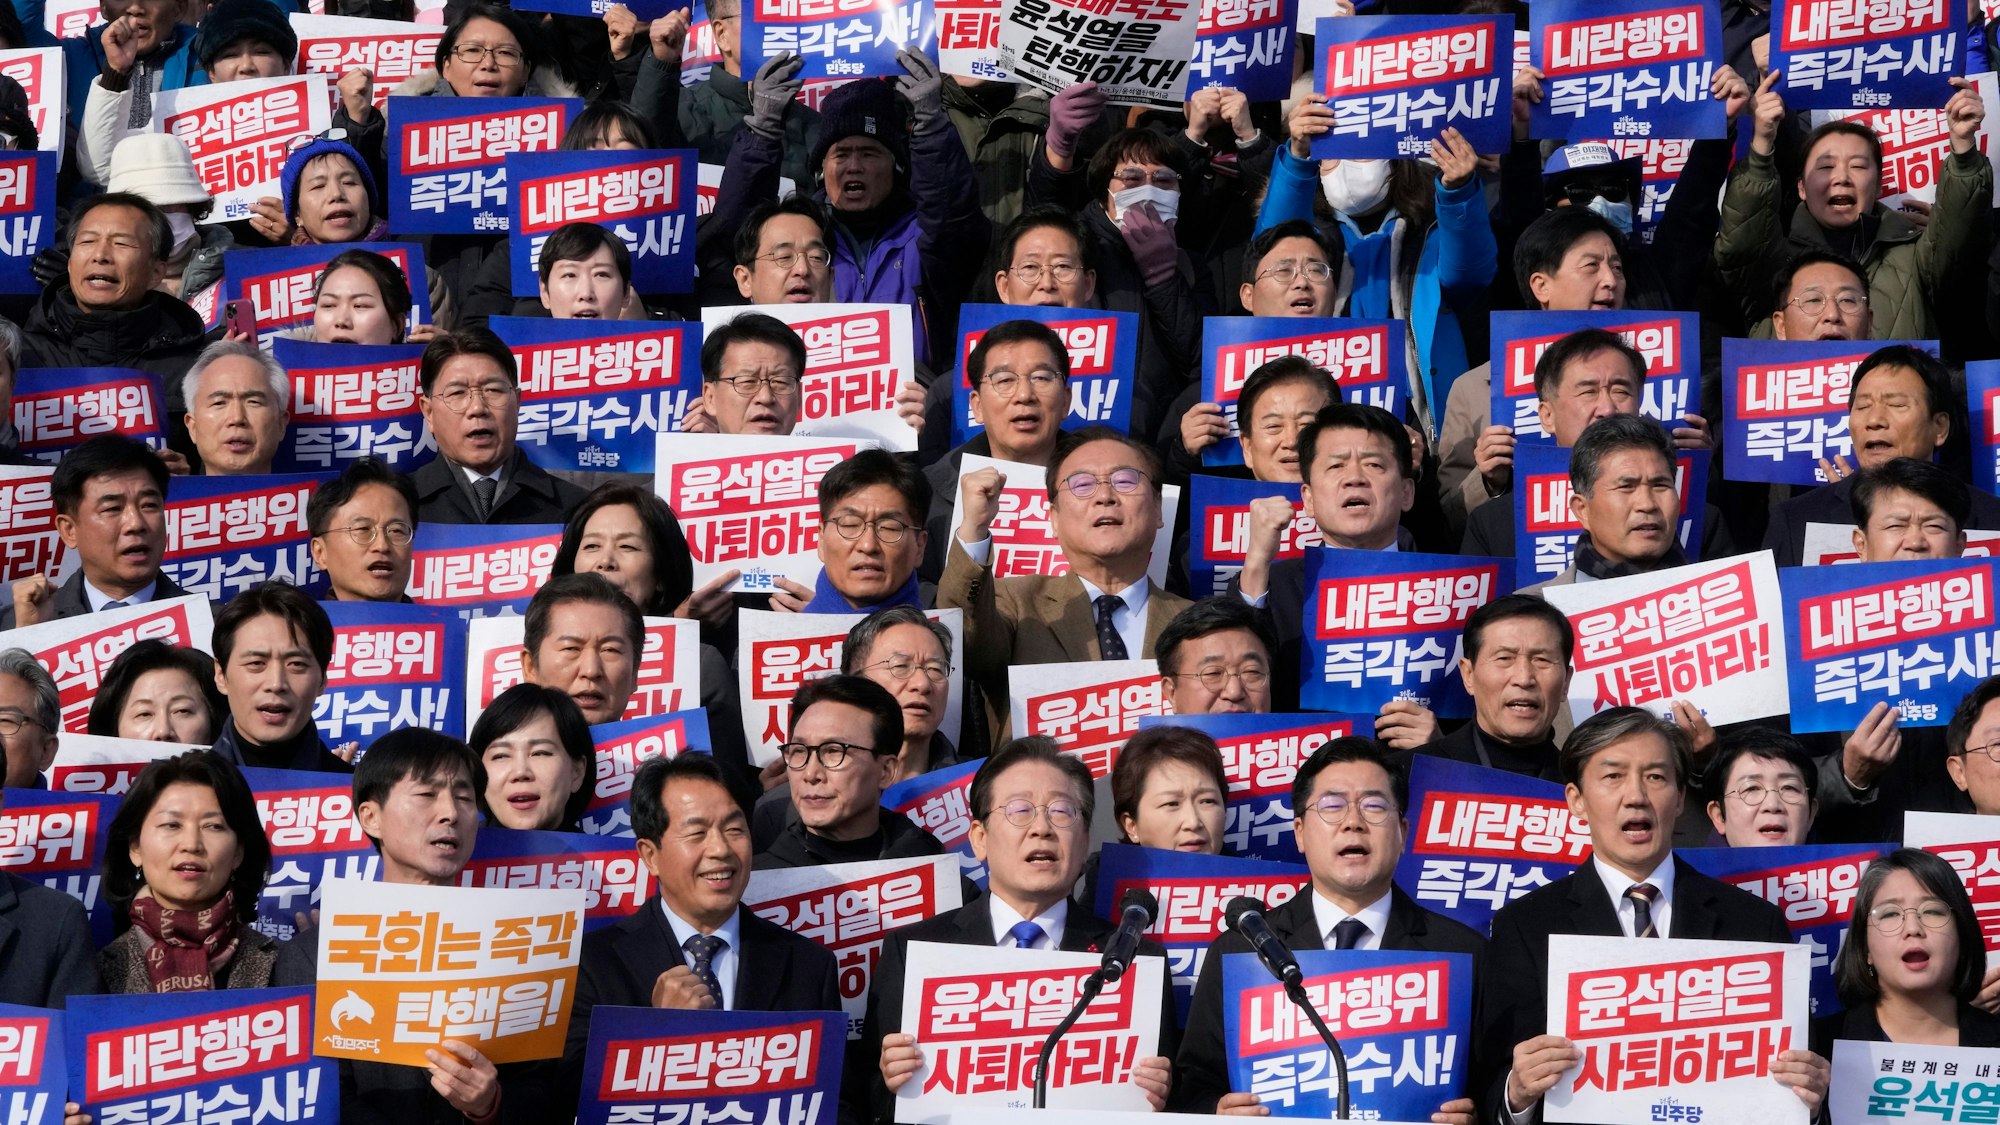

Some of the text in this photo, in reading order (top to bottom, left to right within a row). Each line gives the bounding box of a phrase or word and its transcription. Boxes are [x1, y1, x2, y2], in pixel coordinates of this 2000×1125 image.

[762, 3, 922, 57] 즉각수사!
[1009, 0, 1162, 54] 윤석열을
[1189, 26, 1288, 78] 각수사!
[1551, 13, 1698, 69] 내란행위
[306, 41, 440, 76] 윤석열은
[826, 62, 865, 75] 민주당
[1022, 36, 1187, 90] 탄핵하자!
[1334, 29, 1487, 88] 내란행위
[1787, 33, 1956, 90] 즉각수사!
[1334, 78, 1500, 138] 즉각수사!
[1550, 61, 1712, 118] 즉각수사!
[1852, 93, 1892, 107] 민주당
[172, 93, 301, 155] 윤석열은
[409, 111, 558, 167] 내란행위
[1613, 120, 1651, 136] 민주당
[225, 202, 260, 219] 민주
[410, 165, 506, 213] 즉각수
[527, 163, 674, 226] 내란행위
[473, 216, 510, 231] 민주당
[514, 336, 674, 400] 내란행위
[801, 316, 880, 368] 열은
[1224, 333, 1381, 393] 내행위
[1514, 326, 1673, 387] 내위
[296, 367, 425, 416] 내란행
[800, 369, 897, 422] 하라!
[1514, 379, 1688, 439] 즉사!
[1746, 361, 1860, 411] 내란행
[296, 420, 438, 467] 즉각수
[516, 389, 686, 446] 즉각수사!
[1746, 416, 1853, 462] 즉각수
[577, 451, 620, 468] 민주당
[680, 453, 843, 511] 윤석열은
[990, 494, 1053, 537] 윤석
[165, 545, 321, 601] 각수사!
[406, 543, 557, 599] 내란행위
[1325, 572, 1490, 630] 내란행위
[1578, 573, 1745, 661] 윤석열은
[1810, 572, 1986, 650] 내란행위
[760, 641, 843, 693] 윤석
[1324, 634, 1463, 688] 즉각수
[1593, 623, 1771, 713] 사퇴하라!
[1815, 631, 2000, 705] 즉각수사!
[312, 688, 448, 739] 각수사!
[1037, 681, 1174, 742] 윤석열
[0, 811, 88, 866] 행위
[1425, 800, 1592, 857] 내란행위
[263, 856, 379, 909] 수사!
[1416, 859, 1553, 910] 즉각수
[1732, 861, 1868, 922] 행위
[328, 911, 577, 973] 국회는 즉각
[393, 978, 566, 1044] 탄핵을!
[931, 971, 1121, 1034] 윤석열은
[1250, 969, 1440, 1046] 내란행위
[1578, 960, 1772, 1031] 윤석열은
[97, 1004, 300, 1092] 내란행위
[322, 1035, 381, 1055] 사회민주당
[611, 1029, 812, 1093] 내란행위
[924, 1036, 1139, 1095] 사퇴하라!
[1250, 1035, 1457, 1107] 즉각수사!
[1573, 1026, 1792, 1094] 사퇴하라!
[1651, 1104, 1703, 1123] 민주당
[1867, 1076, 2000, 1125] 윤석열
